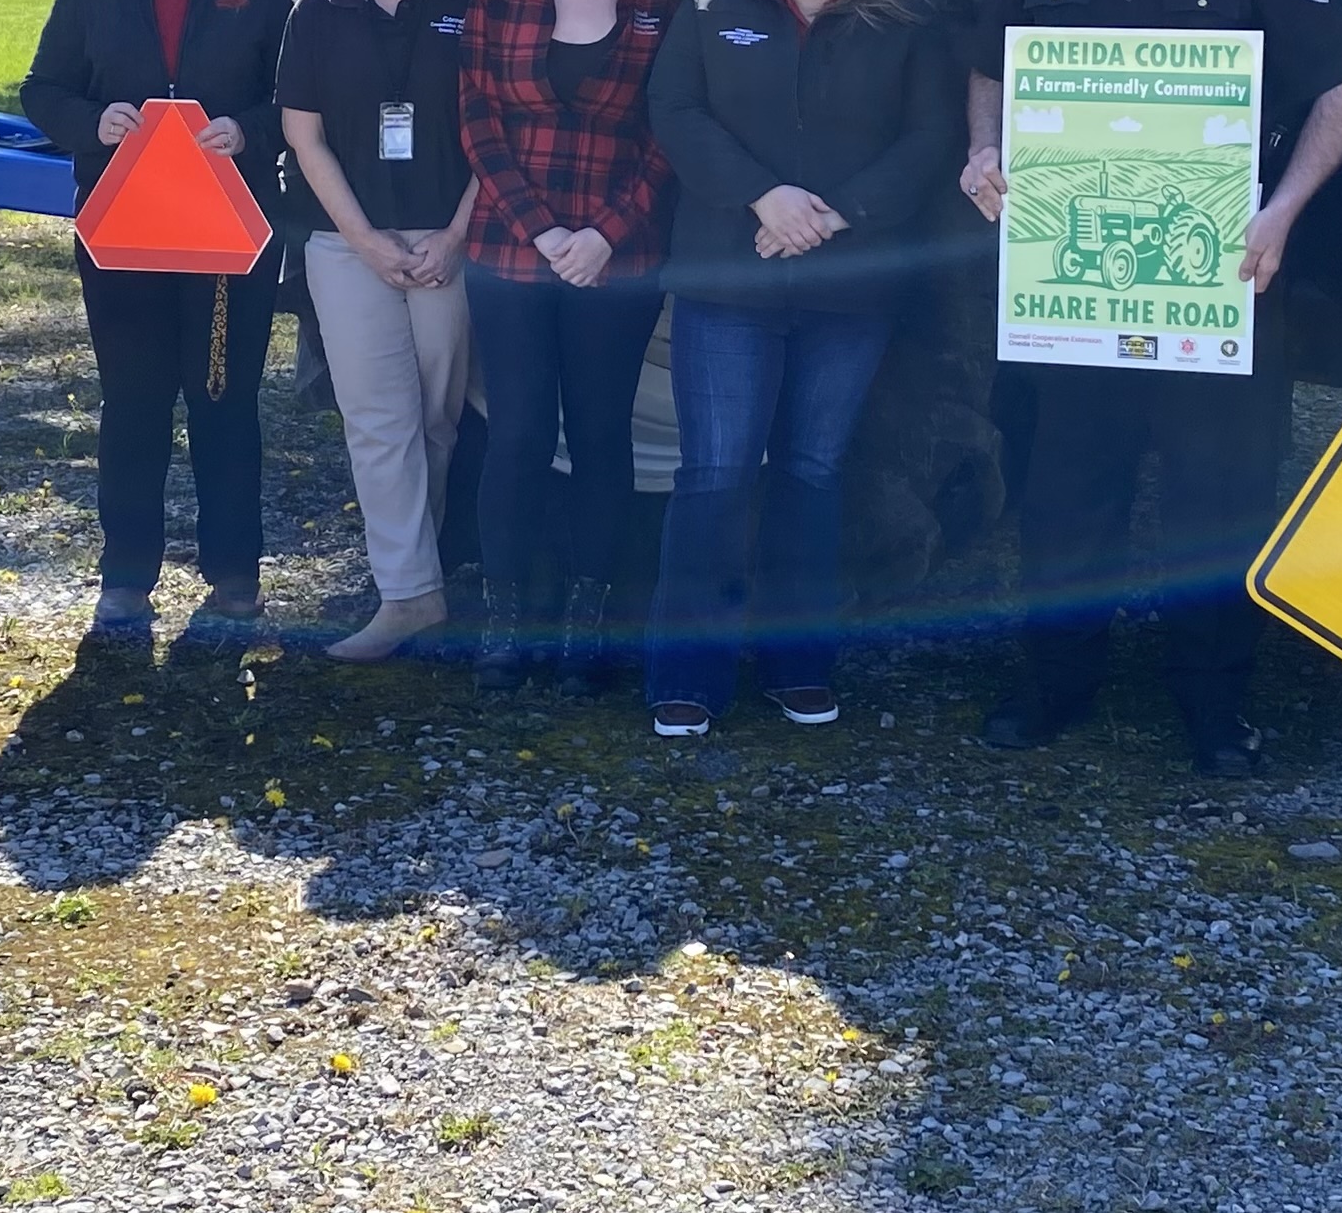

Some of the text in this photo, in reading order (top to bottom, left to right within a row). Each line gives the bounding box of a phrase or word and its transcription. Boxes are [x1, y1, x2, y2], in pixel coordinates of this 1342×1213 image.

[1027, 40, 1242, 69] ONEIDA COUNTY
[1019, 76, 1247, 102] A Farm-Friendly Community
[1013, 293, 1241, 329] SHARE THE ROAD
[1031, 333, 1070, 342] Cooperative
[1031, 341, 1054, 350] County
